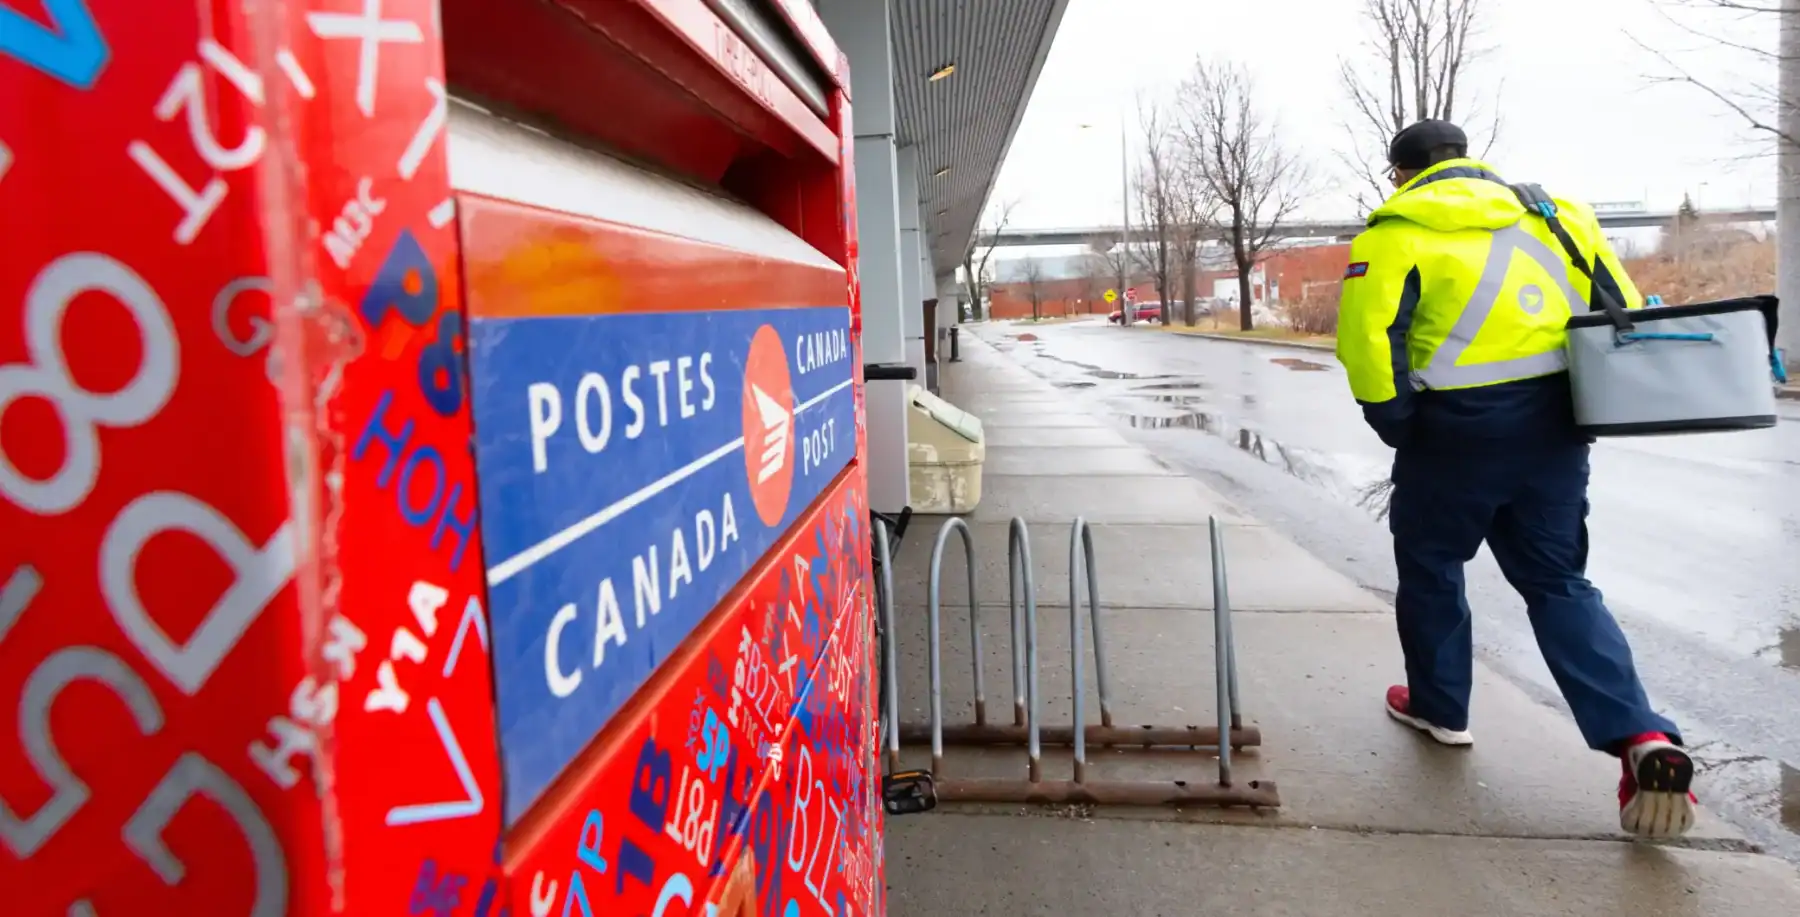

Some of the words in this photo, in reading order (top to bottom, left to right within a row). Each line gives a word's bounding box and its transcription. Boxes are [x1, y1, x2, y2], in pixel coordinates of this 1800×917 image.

[796, 327, 847, 375] CANADA
[528, 352, 716, 474] POSTES
[802, 418, 835, 475] POST
[544, 492, 739, 698] CANADA
